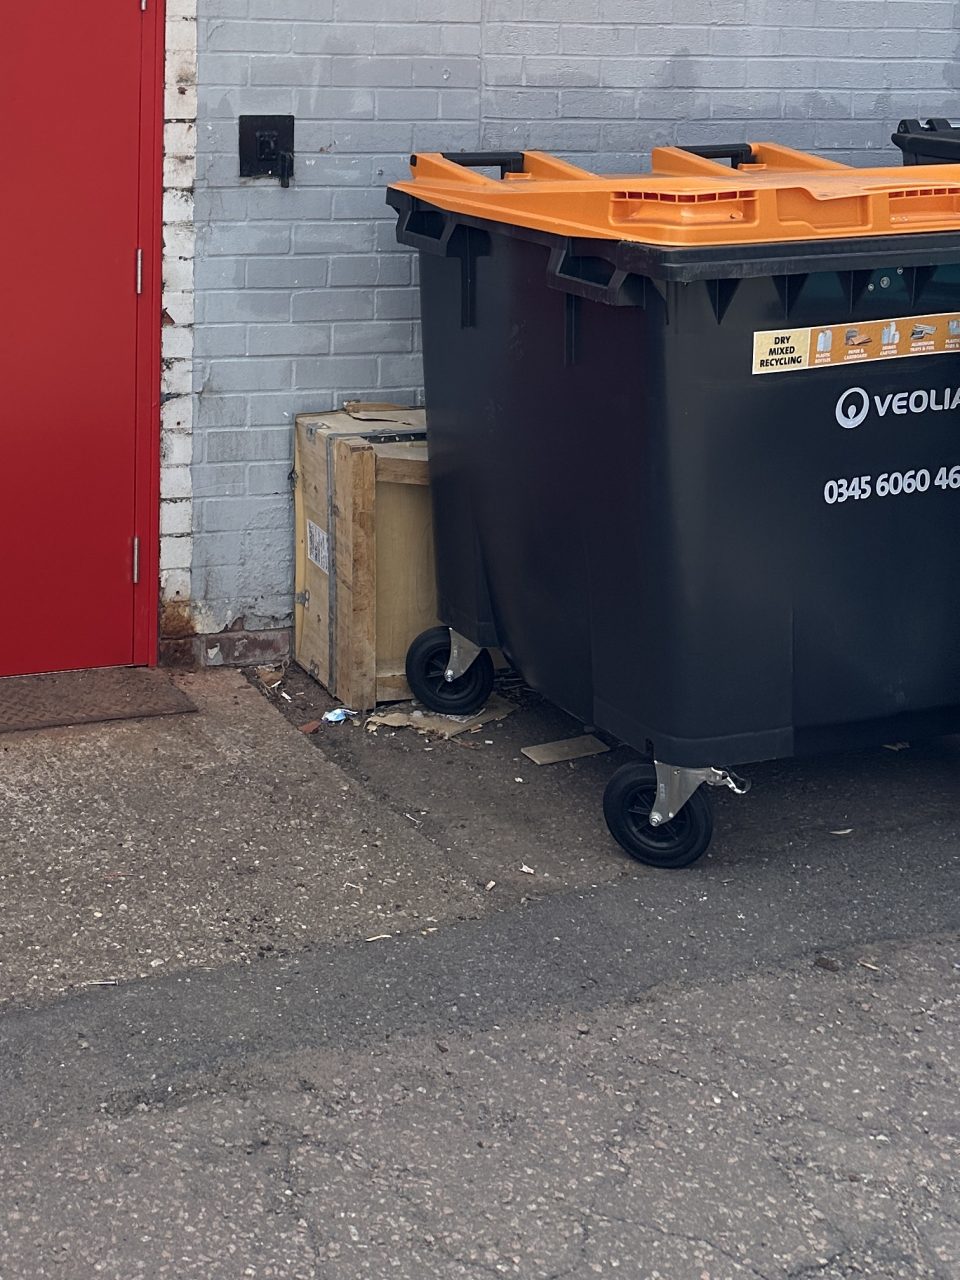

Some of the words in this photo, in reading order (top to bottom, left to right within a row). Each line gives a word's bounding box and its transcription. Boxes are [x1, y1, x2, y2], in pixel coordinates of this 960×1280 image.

[774, 336, 791, 345] DRY
[769, 346, 795, 356] MIXED
[760, 356, 802, 368] RECYCLING
[824, 475, 872, 504] 0345
[876, 469, 931, 497] 6060
